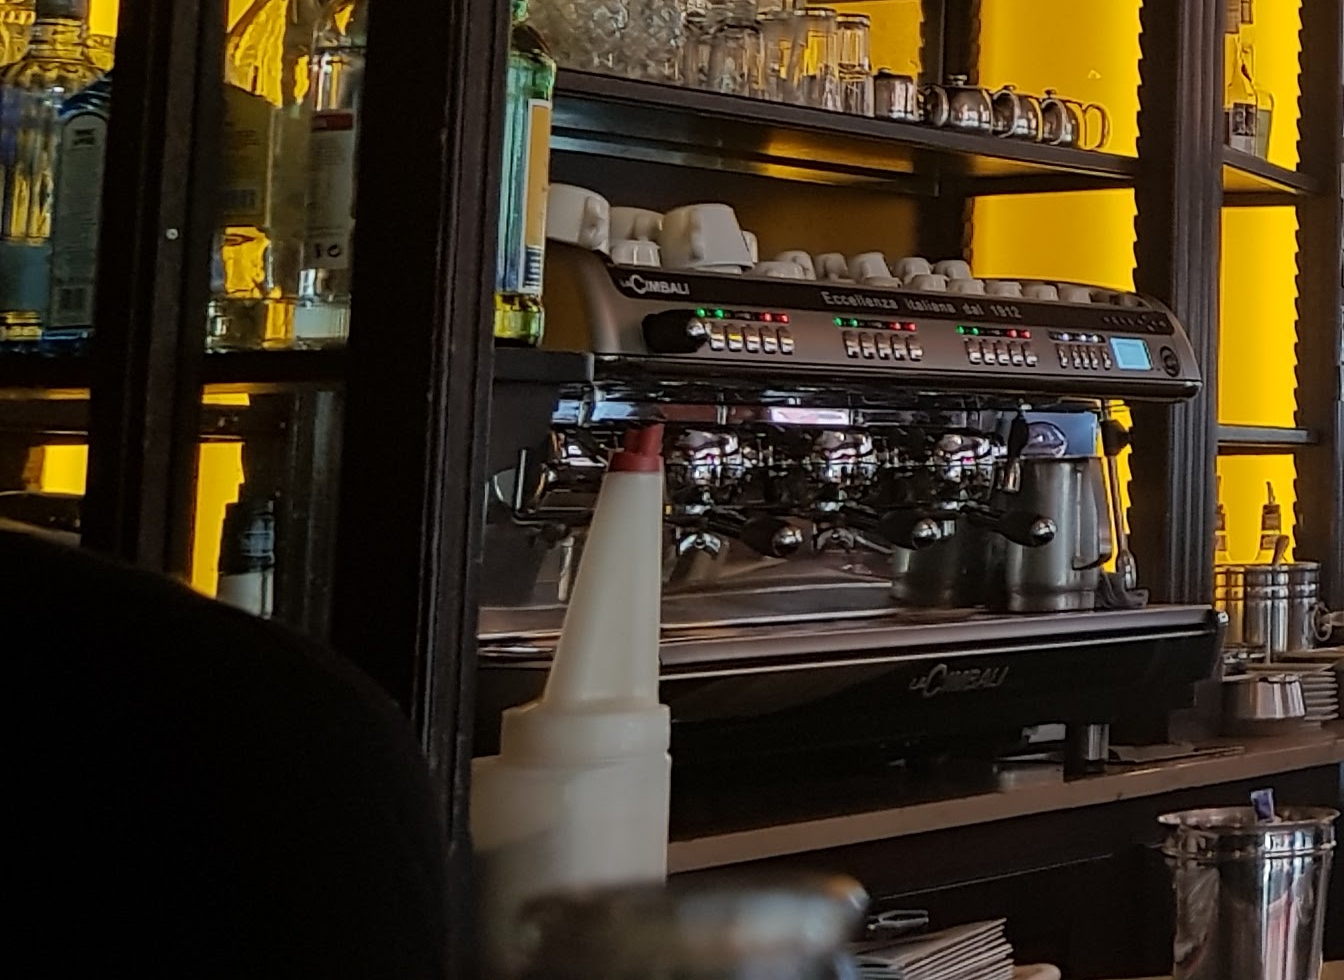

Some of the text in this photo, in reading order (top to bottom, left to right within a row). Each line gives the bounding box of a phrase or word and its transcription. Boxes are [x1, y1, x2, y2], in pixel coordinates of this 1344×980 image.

[821, 291, 899, 310] Eccellenza
[962, 303, 985, 316] dal
[990, 305, 1022, 319] 1912
